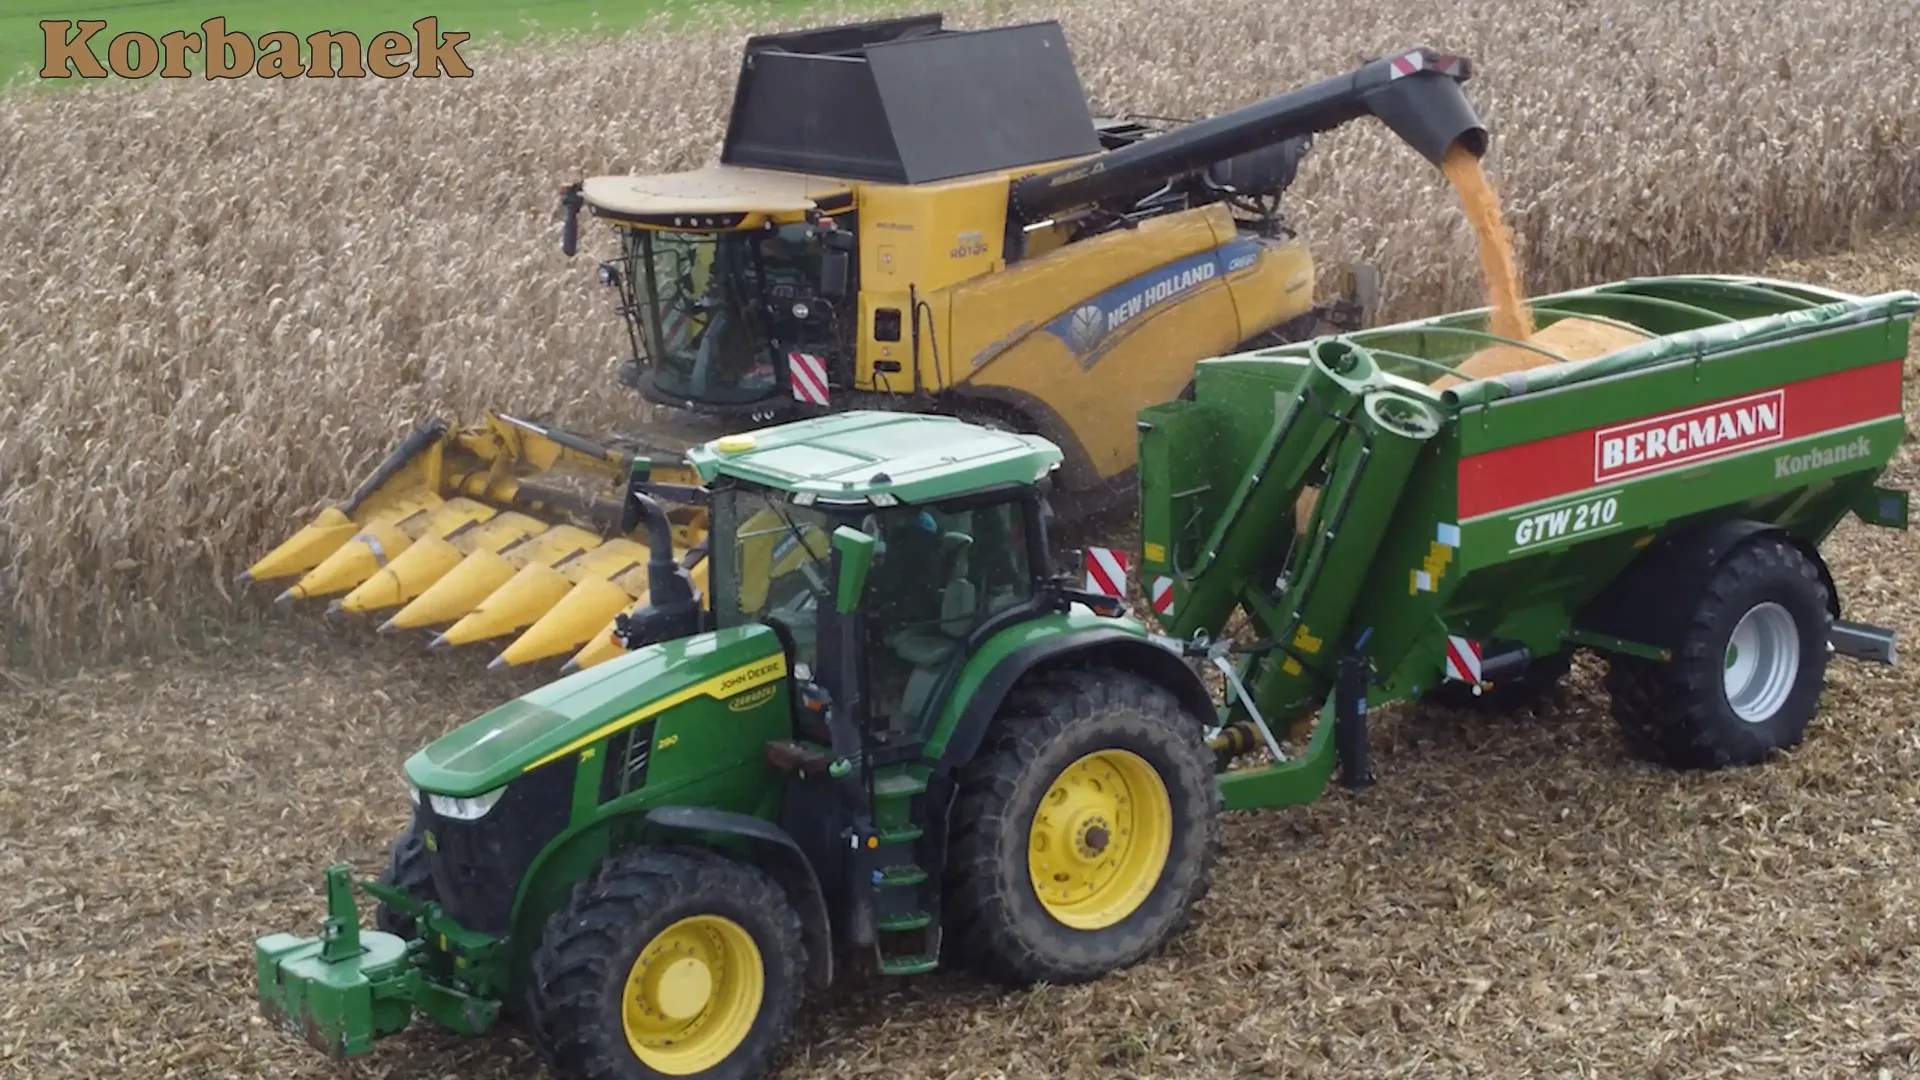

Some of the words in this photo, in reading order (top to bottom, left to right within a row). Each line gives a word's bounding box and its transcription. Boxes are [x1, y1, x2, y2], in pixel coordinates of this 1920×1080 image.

[1107, 294, 1142, 331] NEW
[1144, 262, 1215, 308] HOLLAND
[1602, 402, 1777, 469] BERGMANN
[1774, 435, 1871, 478] Korbanek
[1515, 508, 1572, 545] GTW
[1573, 498, 1617, 531] 210
[720, 674, 746, 691] JOHN
[747, 662, 779, 680] DEERE
